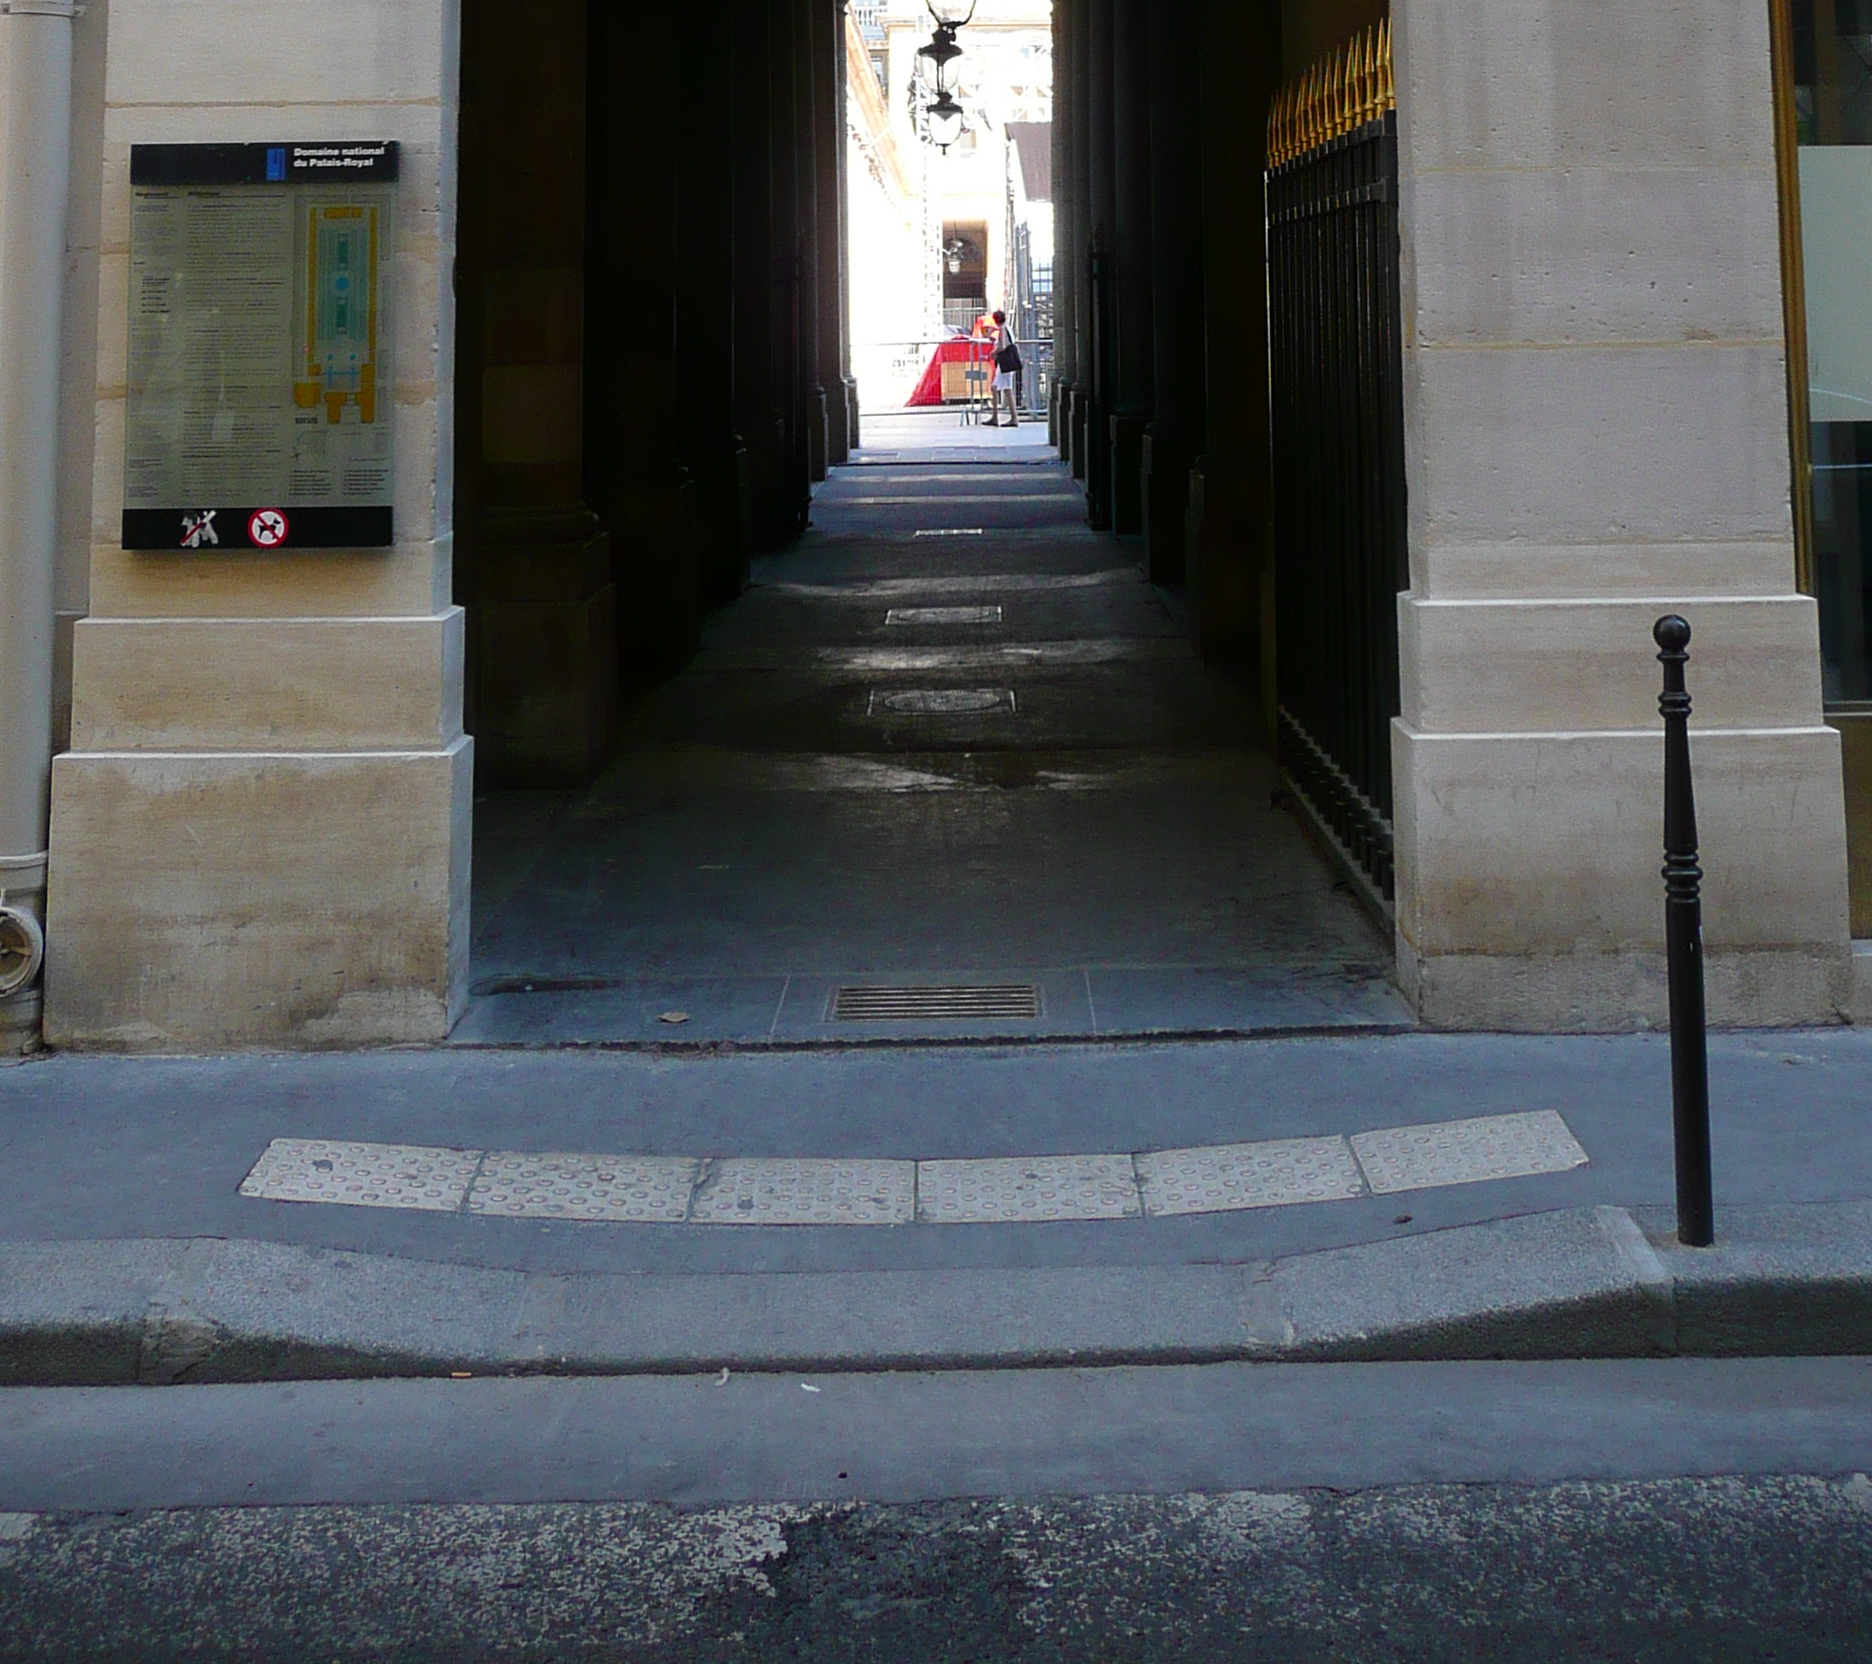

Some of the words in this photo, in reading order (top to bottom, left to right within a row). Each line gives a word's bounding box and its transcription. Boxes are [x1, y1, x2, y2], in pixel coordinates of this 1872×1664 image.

[294, 147, 339, 156] Domaine
[341, 146, 385, 156] national
[293, 159, 307, 167] du
[309, 158, 373, 168] Palais-Royal
